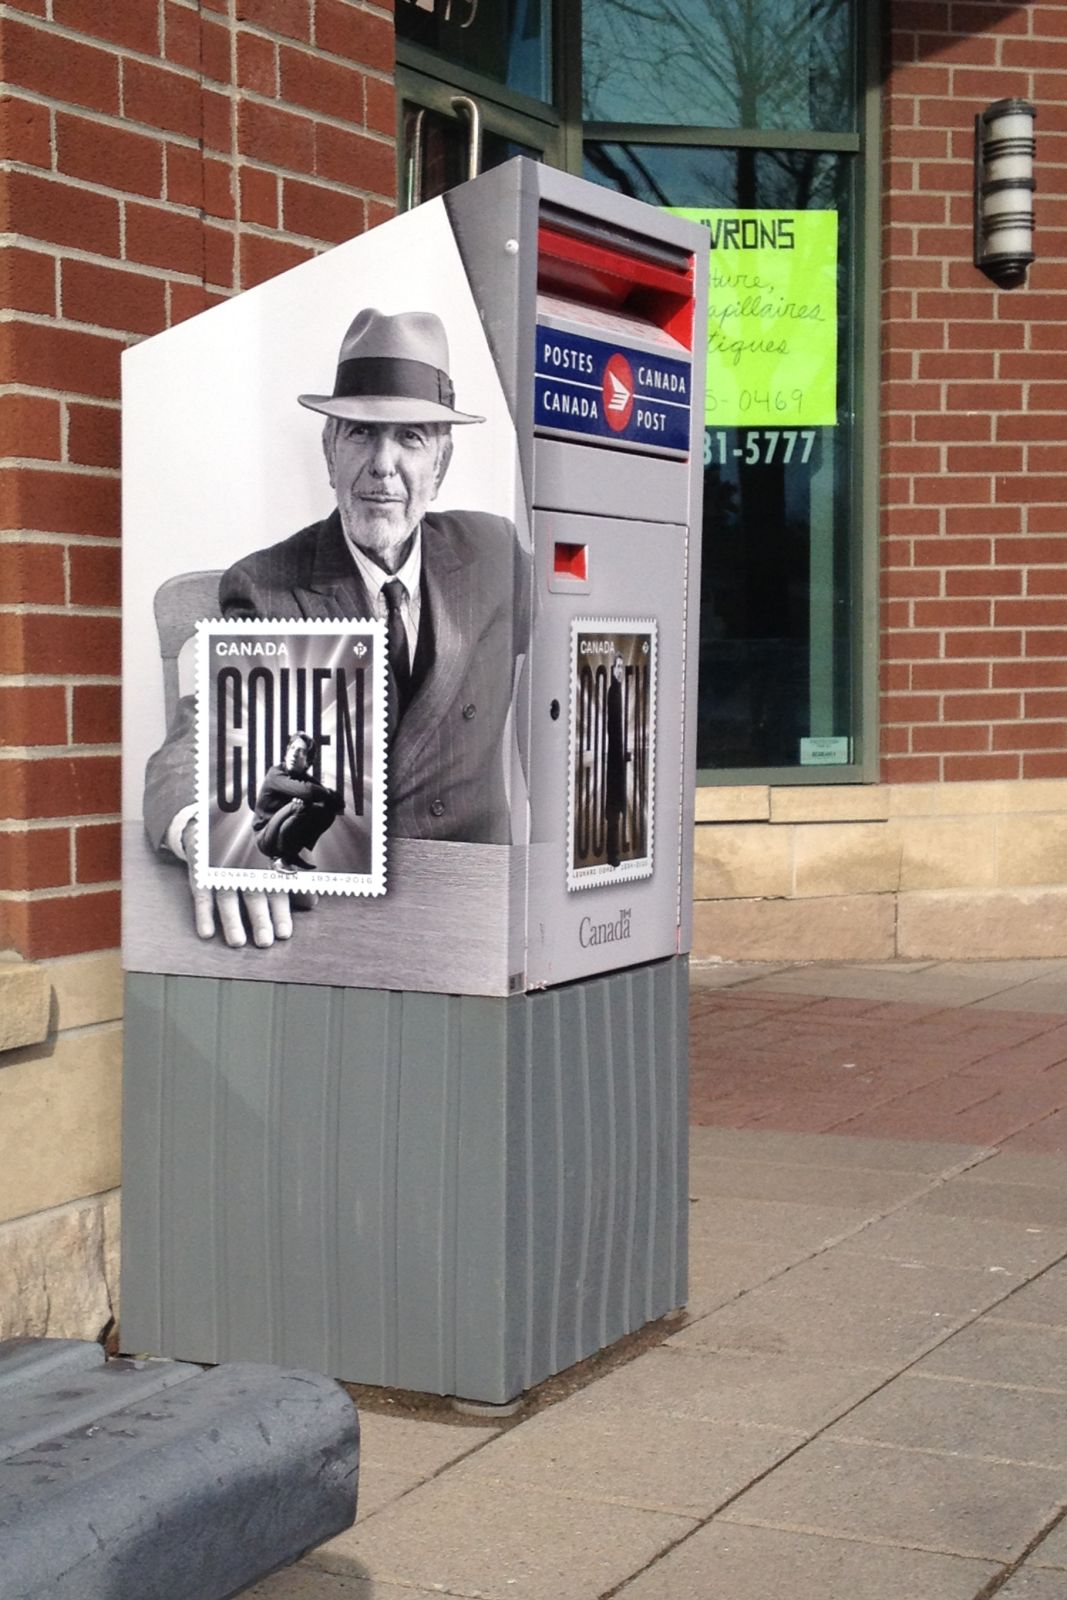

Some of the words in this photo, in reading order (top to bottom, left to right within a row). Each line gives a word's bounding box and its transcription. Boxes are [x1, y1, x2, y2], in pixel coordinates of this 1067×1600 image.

[700, 218, 795, 249] VRONS
[543, 344, 593, 374] POSTES
[637, 366, 686, 394] CANADA
[543, 390, 598, 419] CANADA
[636, 409, 667, 432] POST
[215, 641, 289, 656] CANADA
[580, 640, 615, 655] CANADA
[263, 872, 299, 881] COHEN
[579, 908, 632, 948] Canada
